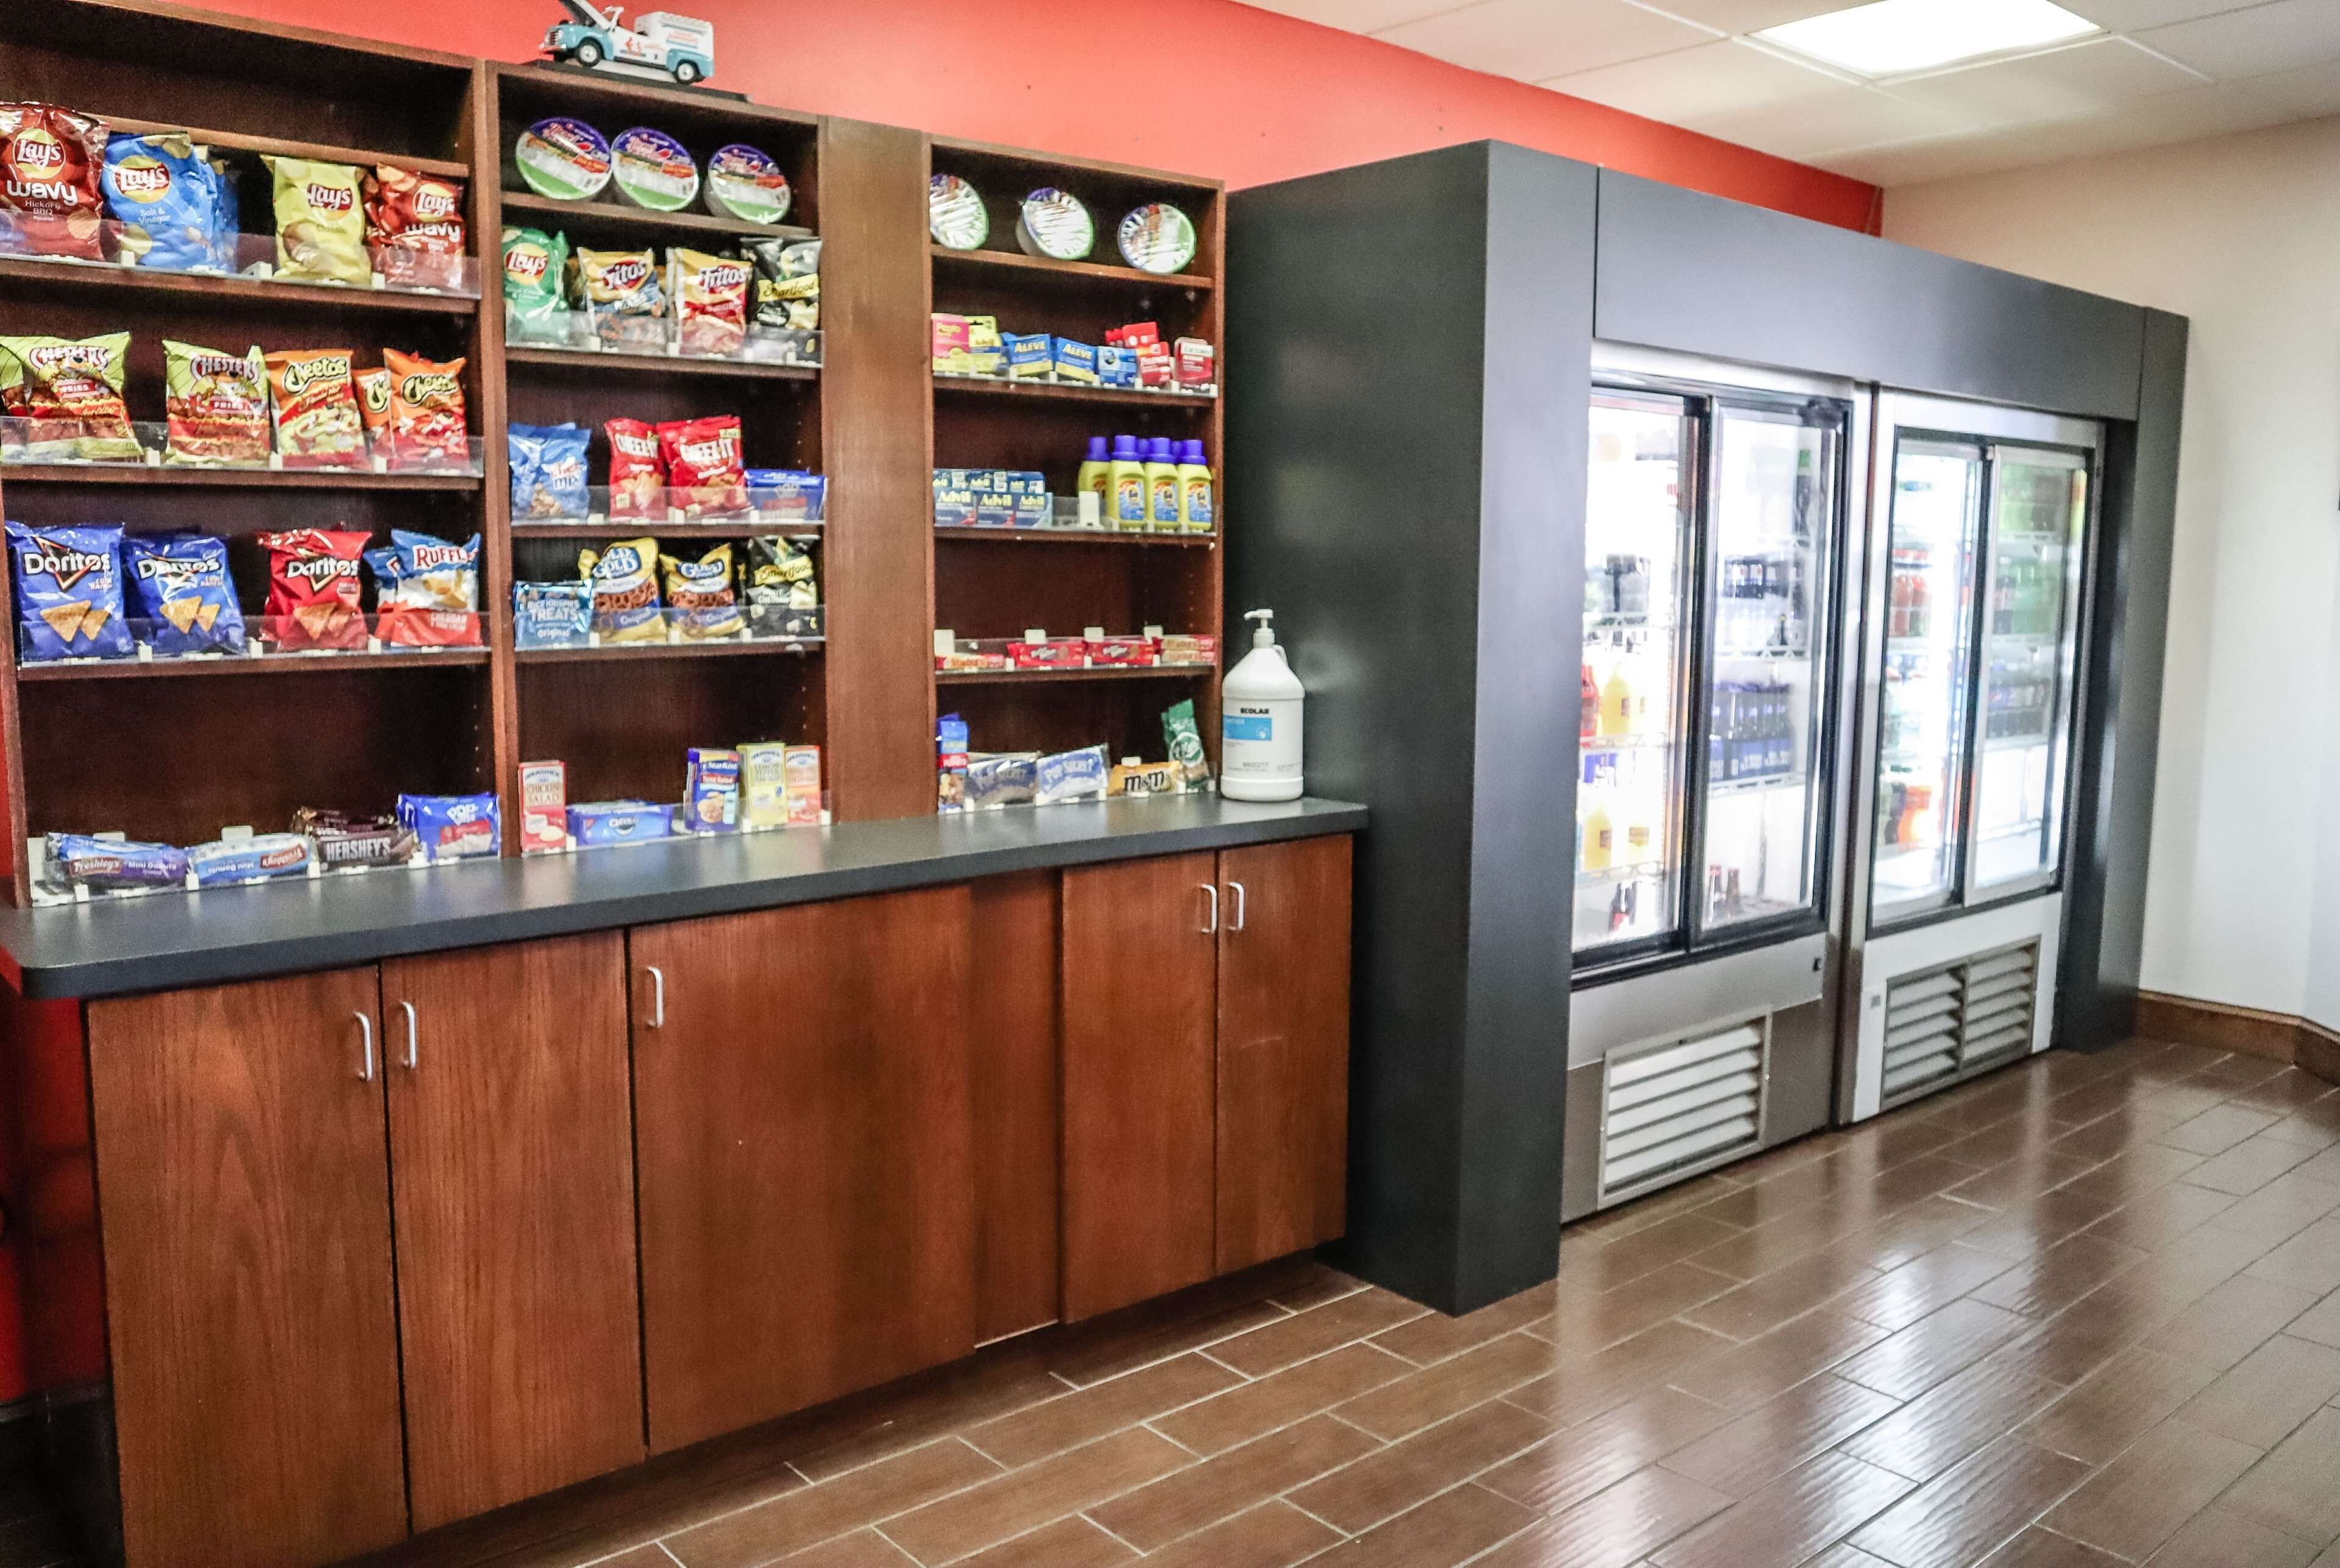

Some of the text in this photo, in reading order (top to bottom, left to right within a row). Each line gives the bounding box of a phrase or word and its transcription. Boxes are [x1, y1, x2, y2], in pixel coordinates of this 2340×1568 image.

[7, 180, 77, 206] wavy
[26, 200, 61, 210] Hickory
[405, 222, 461, 243] wavy
[701, 266, 746, 292] Fritos
[284, 358, 347, 394] Cheetos
[24, 552, 111, 575] Doritos
[287, 557, 360, 578] Doritos
[531, 609, 580, 622] TREATS
[620, 607, 651, 625] Original
[537, 628, 570, 639] Original
[325, 837, 391, 862] HERSHEY'S
